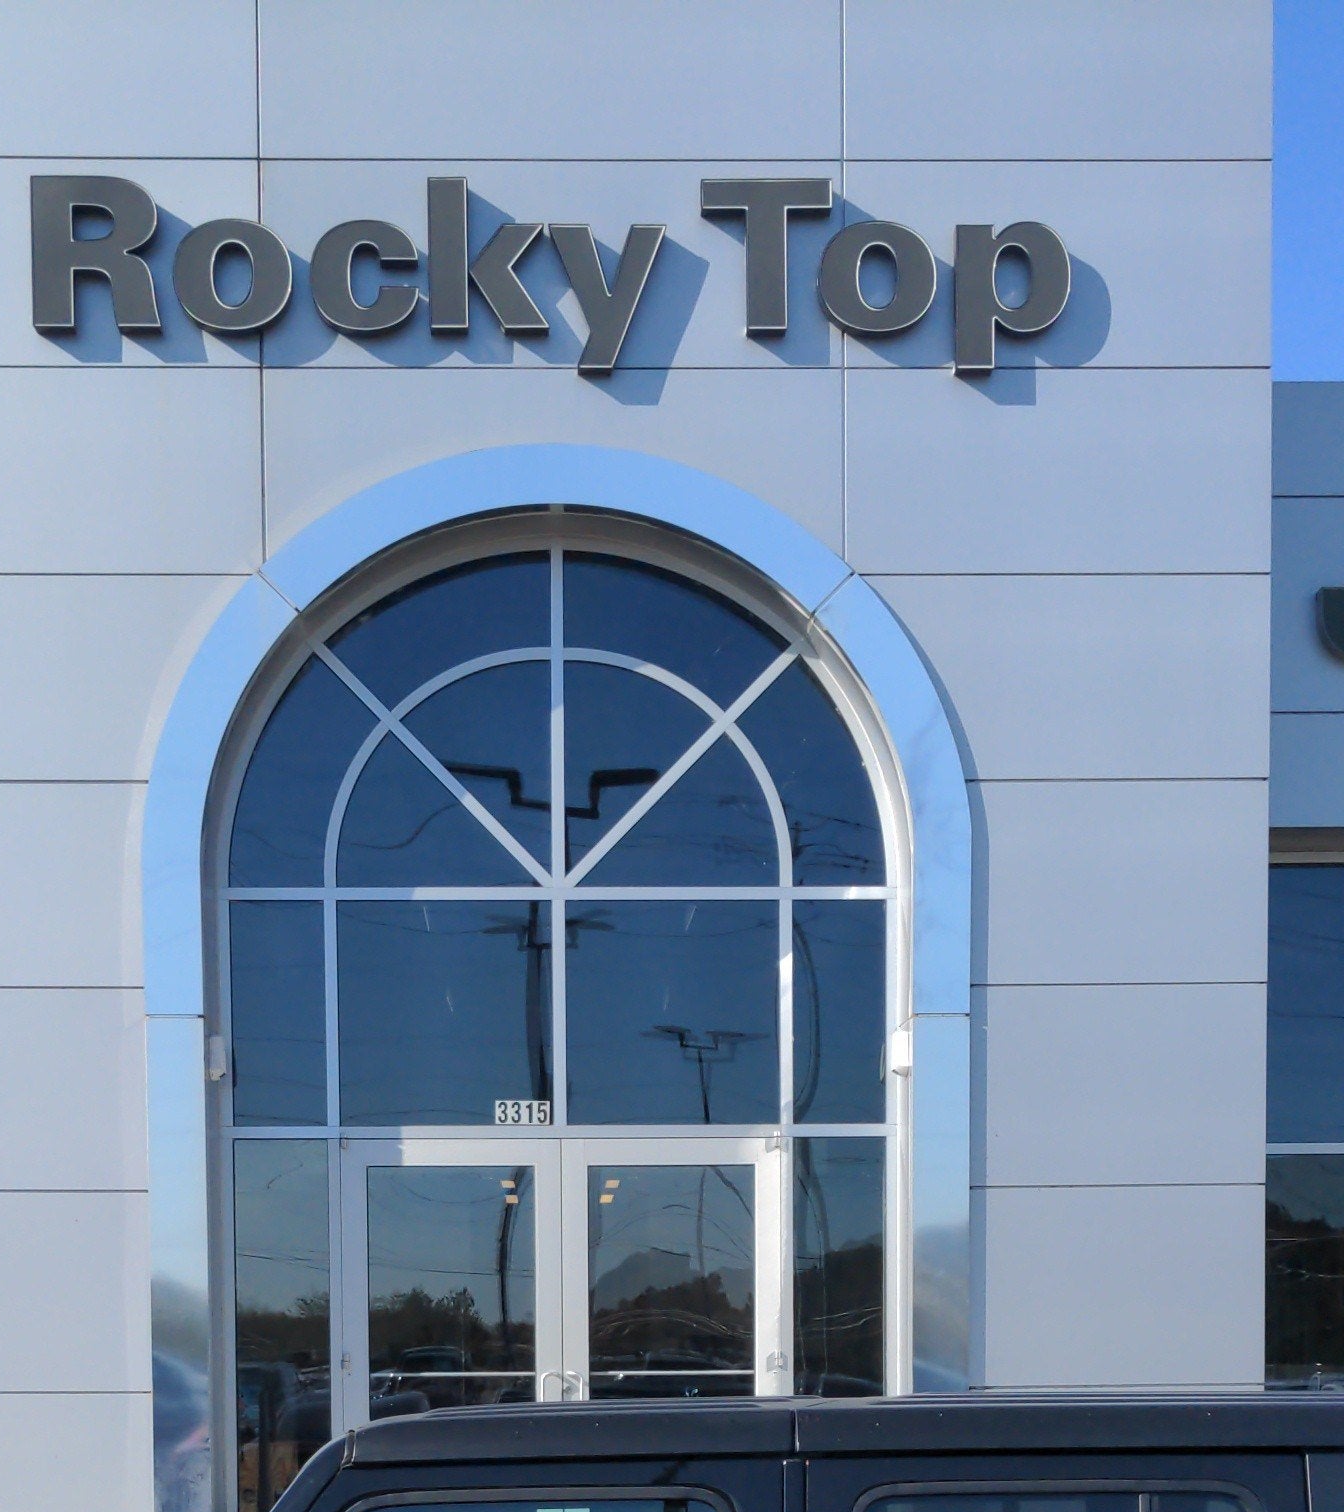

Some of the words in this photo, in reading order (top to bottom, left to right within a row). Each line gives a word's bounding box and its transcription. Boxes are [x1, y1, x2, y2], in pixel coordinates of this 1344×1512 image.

[30, 174, 666, 374] Rocky
[701, 178, 1071, 375] Top
[497, 1102, 548, 1124] 3315
